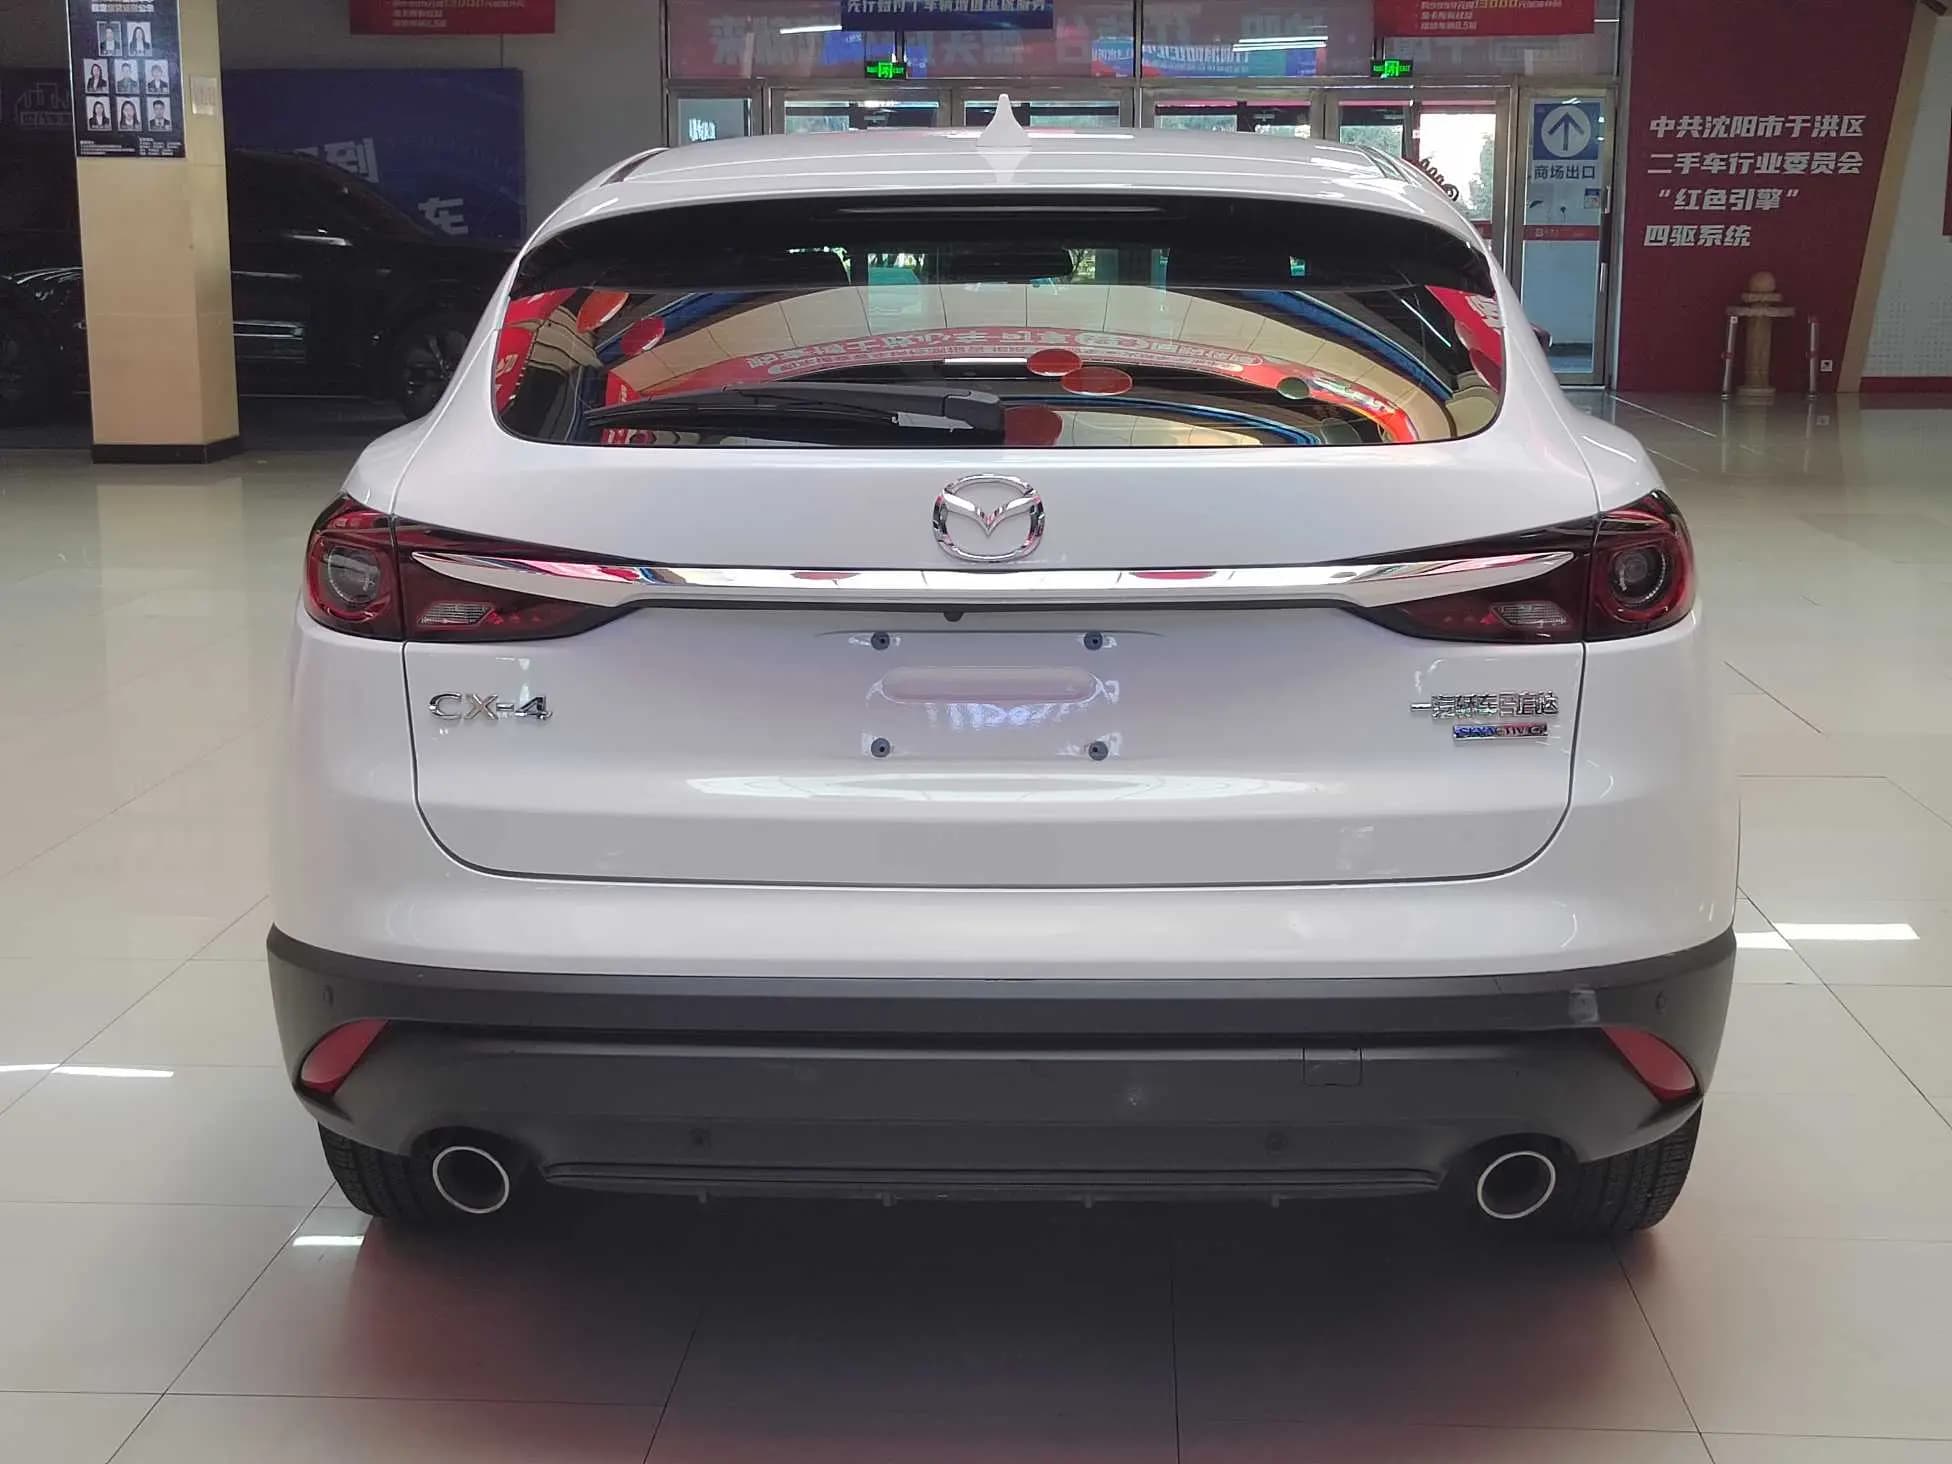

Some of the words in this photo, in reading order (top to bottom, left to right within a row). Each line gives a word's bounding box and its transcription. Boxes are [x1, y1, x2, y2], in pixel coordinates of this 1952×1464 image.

[1649, 115, 1866, 138] 中共沈阳市于洪区
[1534, 165, 1595, 180] 商场出口
[1648, 152, 1864, 175] 二手车行业委员会
[1644, 225, 1752, 247] 四驱系统
[429, 693, 552, 720] CX-4
